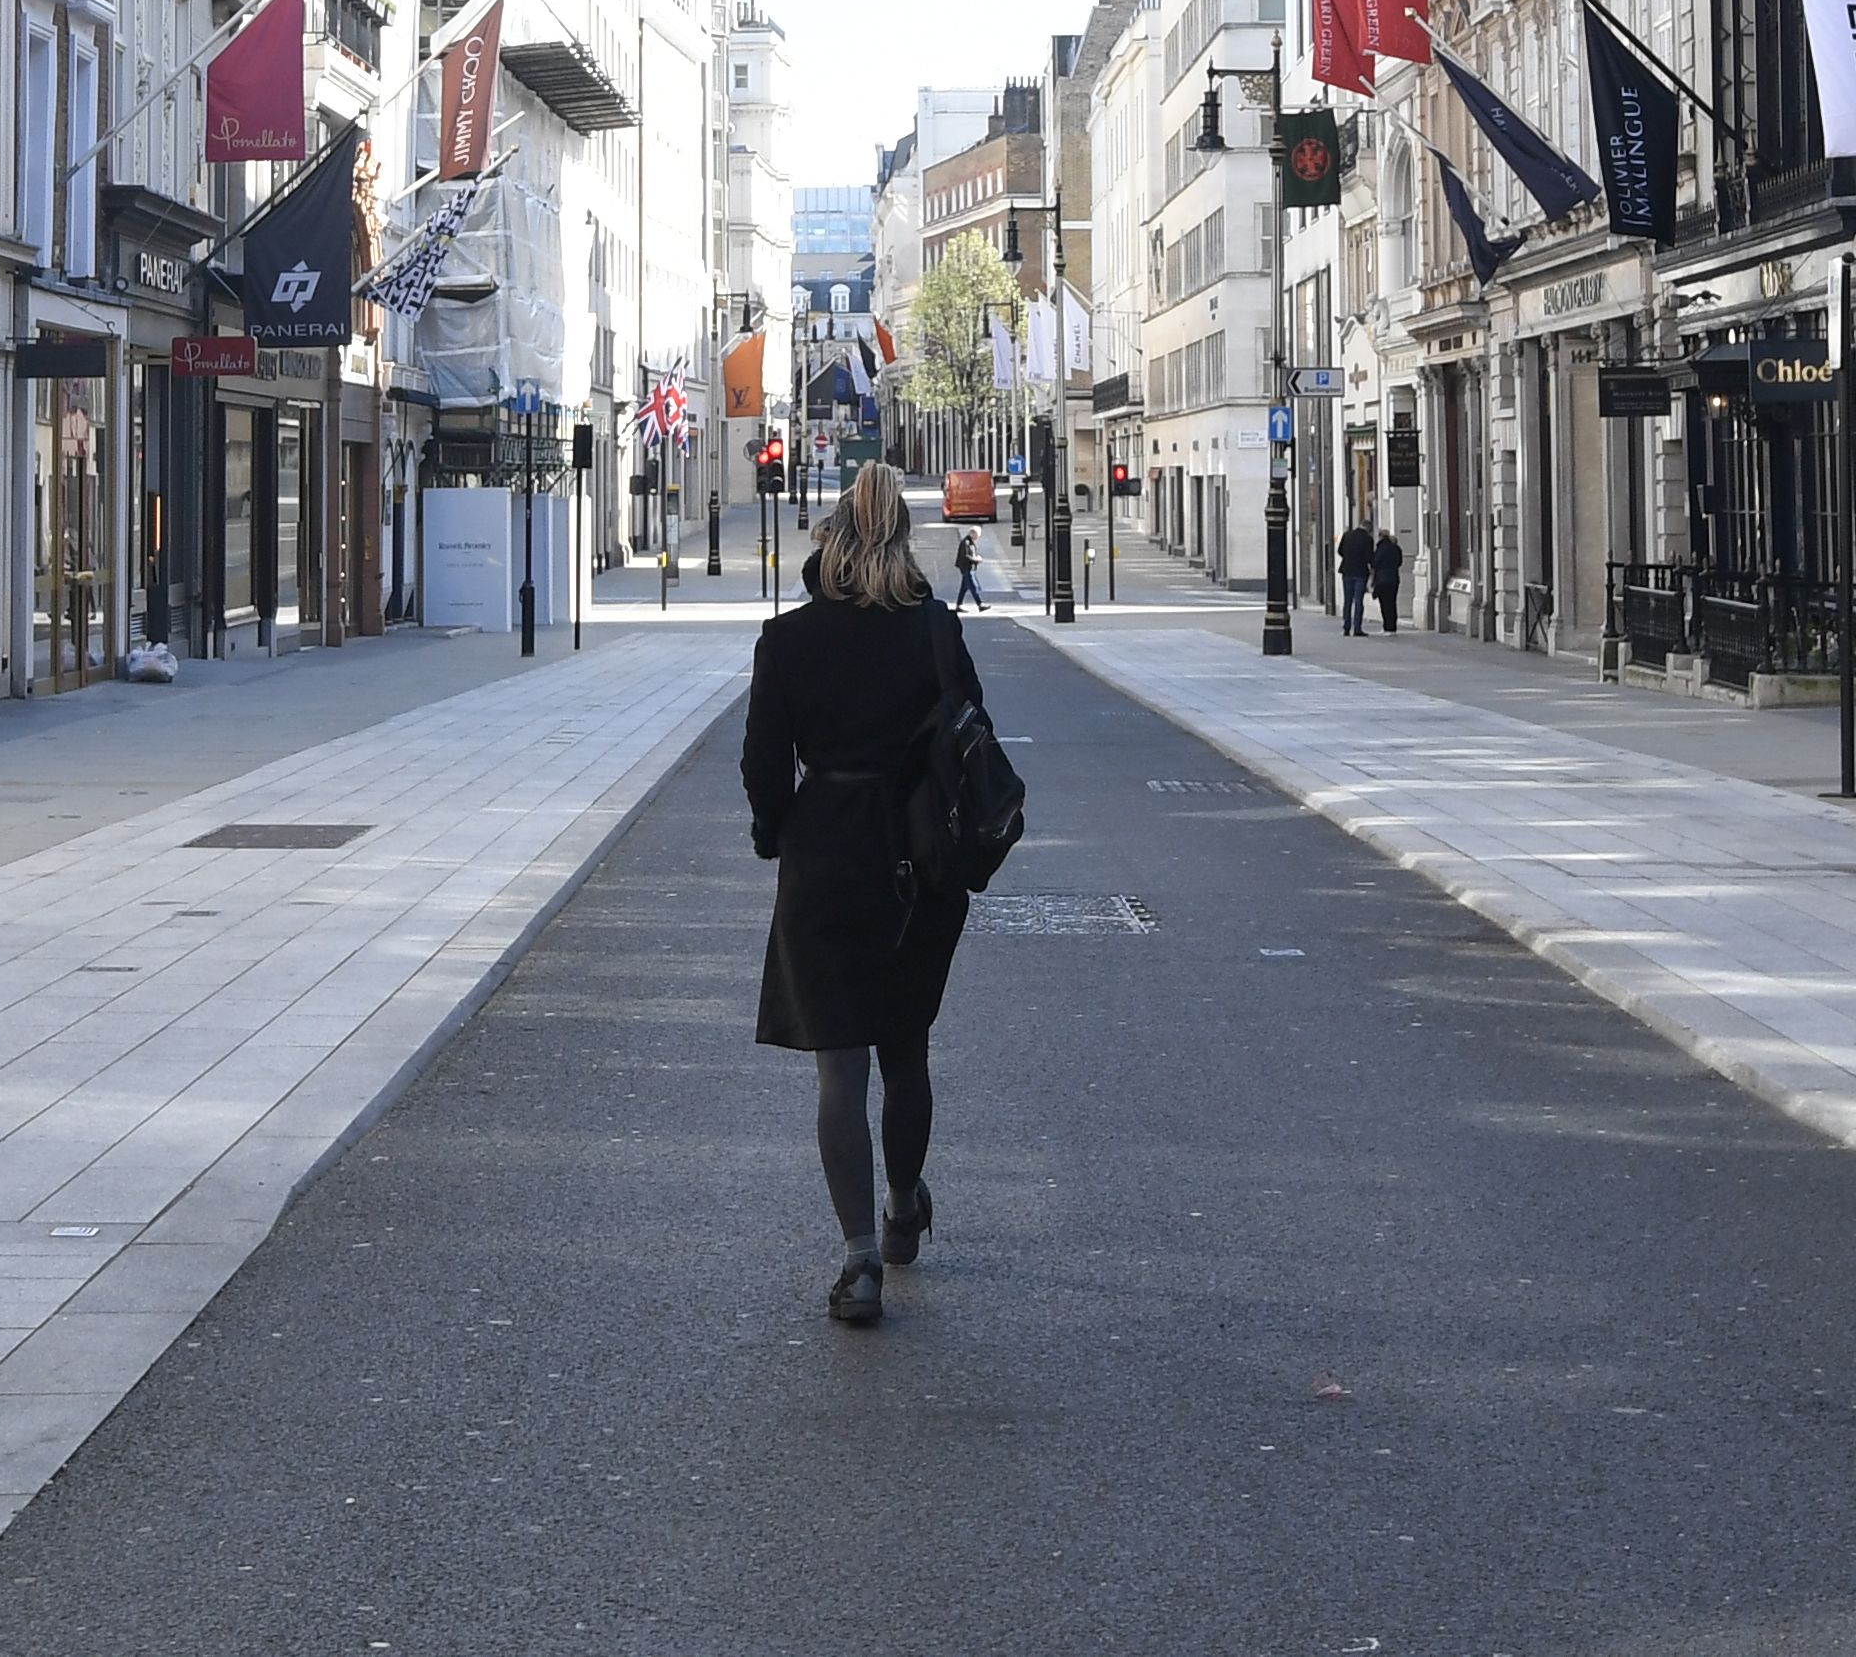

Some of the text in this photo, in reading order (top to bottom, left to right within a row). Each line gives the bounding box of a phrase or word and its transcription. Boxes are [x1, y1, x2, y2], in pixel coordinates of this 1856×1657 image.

[1320, 27, 1333, 76] GREEN
[454, 35, 485, 166] JIMMY CHOO
[211, 115, 298, 151] Pomellato
[1621, 86, 1652, 218] MALINGUE
[1610, 135, 1633, 215] OLIVIER
[140, 251, 184, 294] PANERAI
[249, 322, 346, 338] PANERAI
[1073, 323, 1082, 364] CHANEL
[174, 340, 251, 372] Pomellato
[1756, 357, 1833, 383] Chloé
